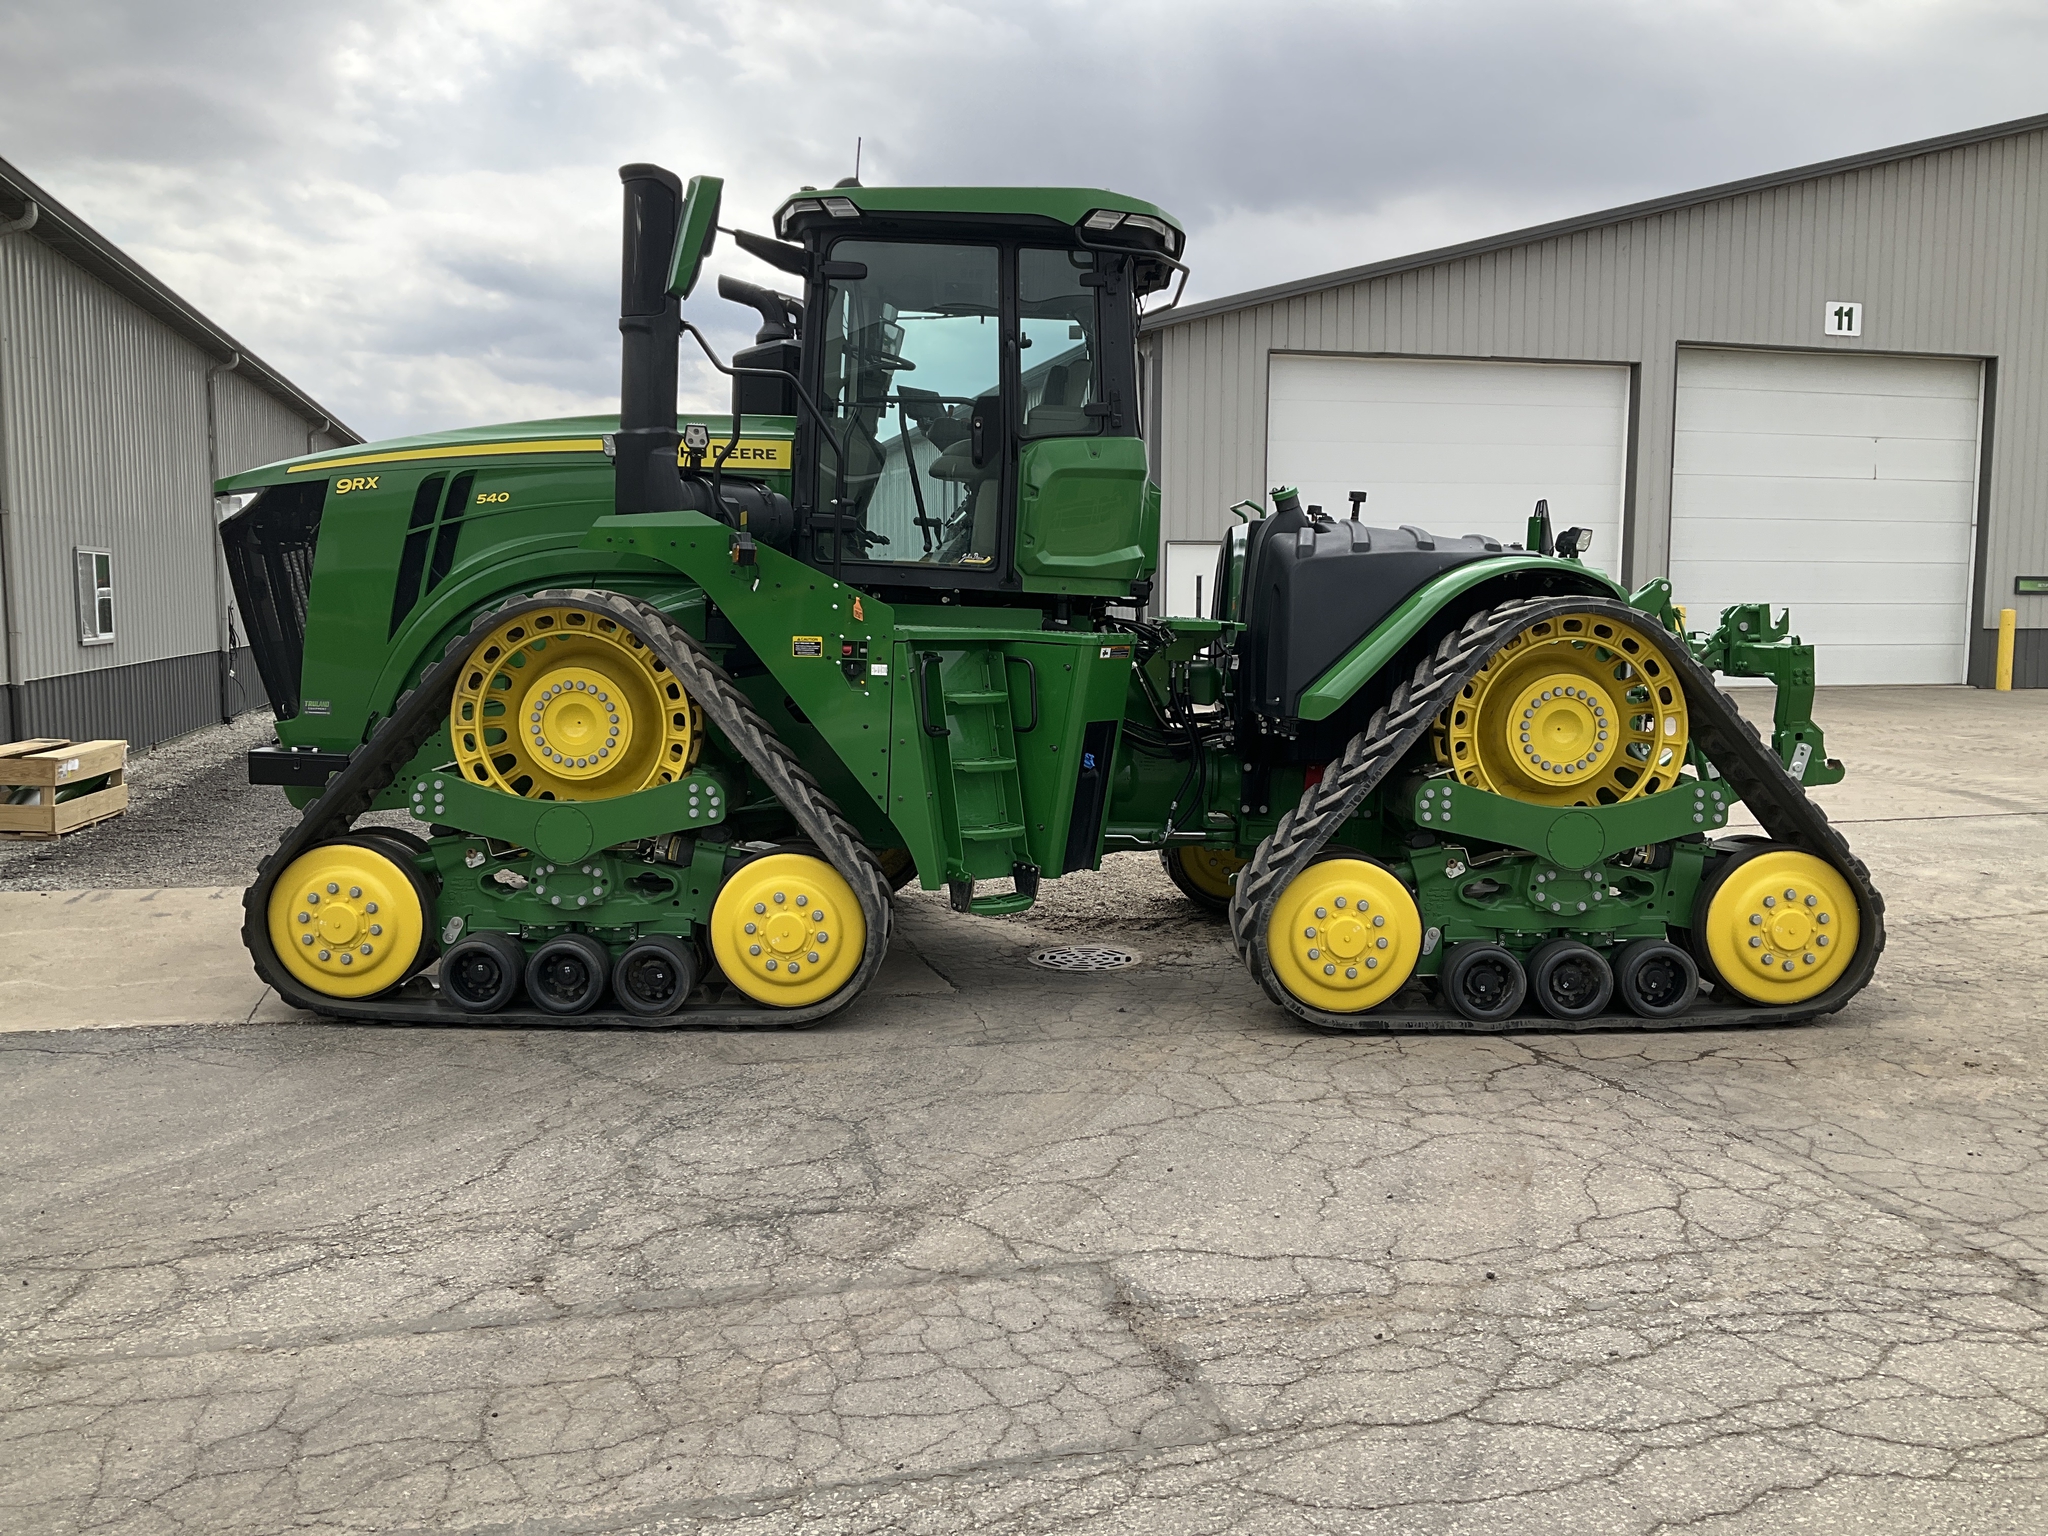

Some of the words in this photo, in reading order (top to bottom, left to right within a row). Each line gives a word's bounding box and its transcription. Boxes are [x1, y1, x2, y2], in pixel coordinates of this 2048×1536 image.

[1834, 306, 1854, 331] 11
[336, 476, 380, 494] 9RX
[476, 492, 510, 504] 540
